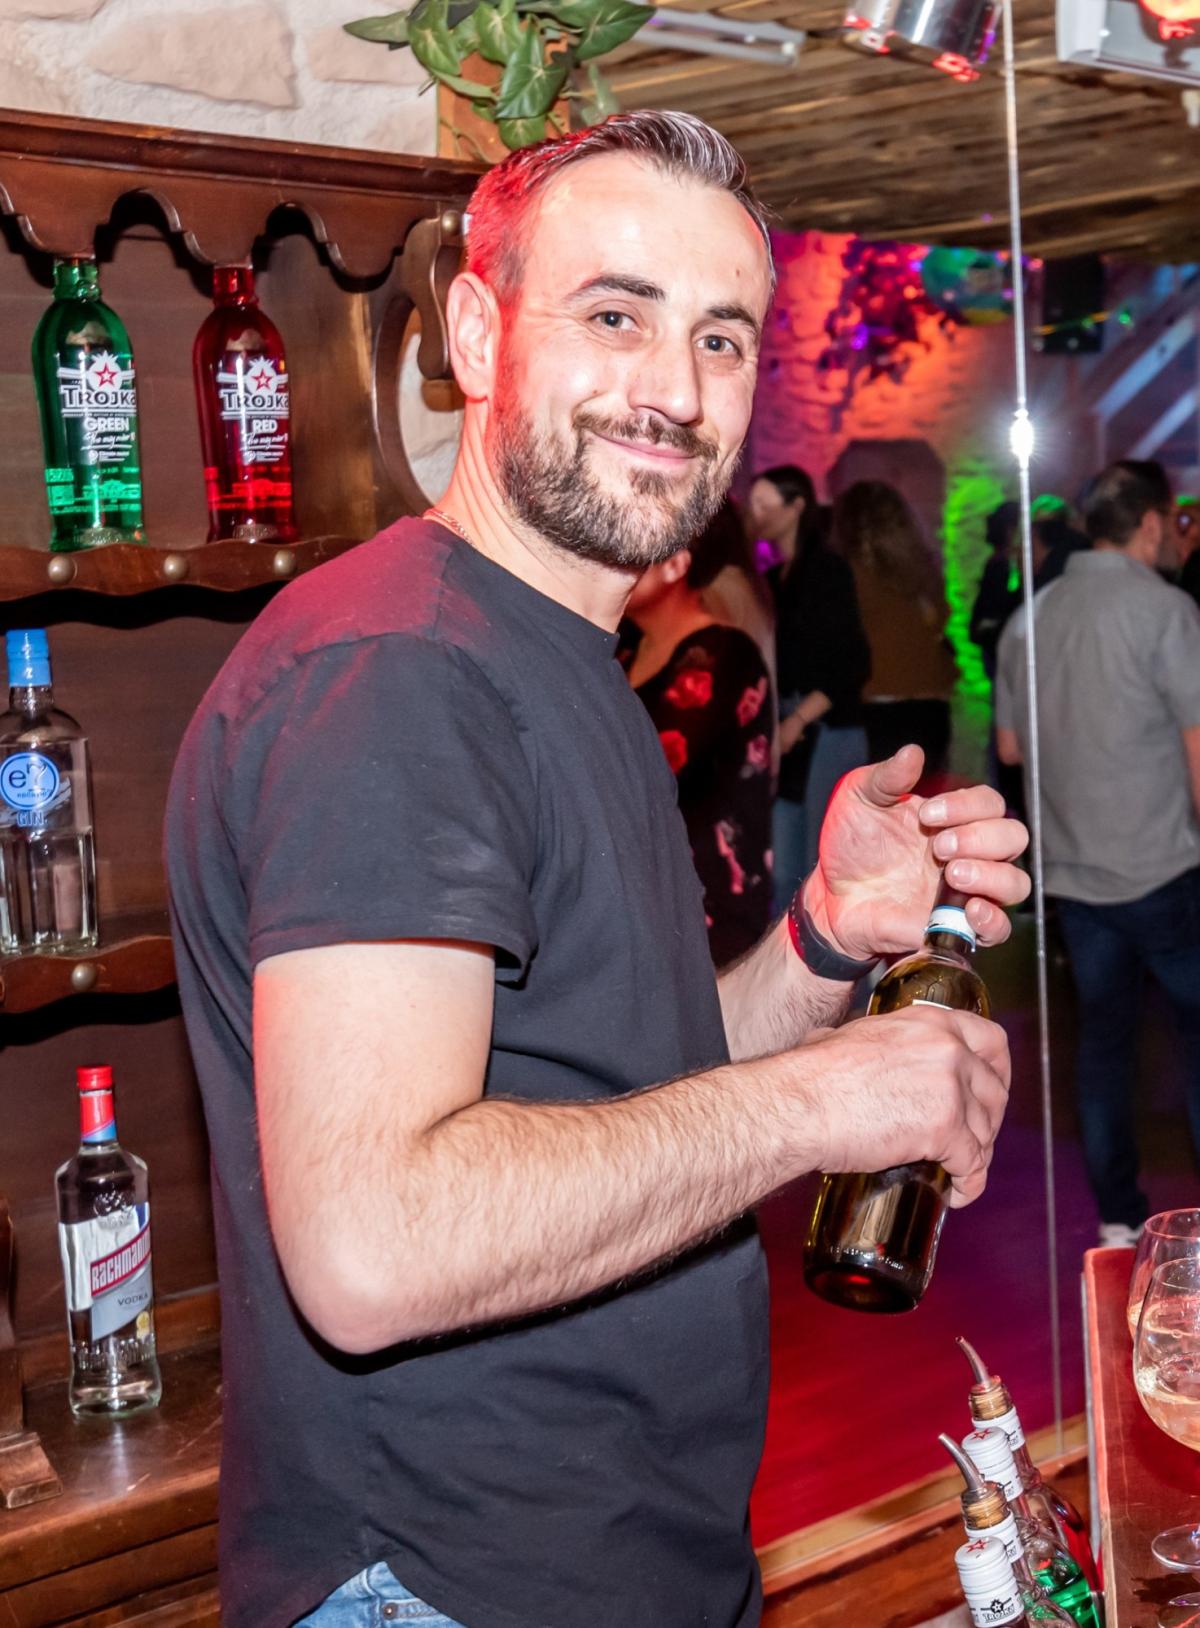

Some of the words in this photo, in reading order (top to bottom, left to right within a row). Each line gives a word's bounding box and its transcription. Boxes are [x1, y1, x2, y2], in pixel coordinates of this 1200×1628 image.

[84, 417, 130, 432] GREEN
[252, 419, 278, 433] RED
[17, 810, 45, 828] GIN
[117, 1293, 148, 1306] VODKA
